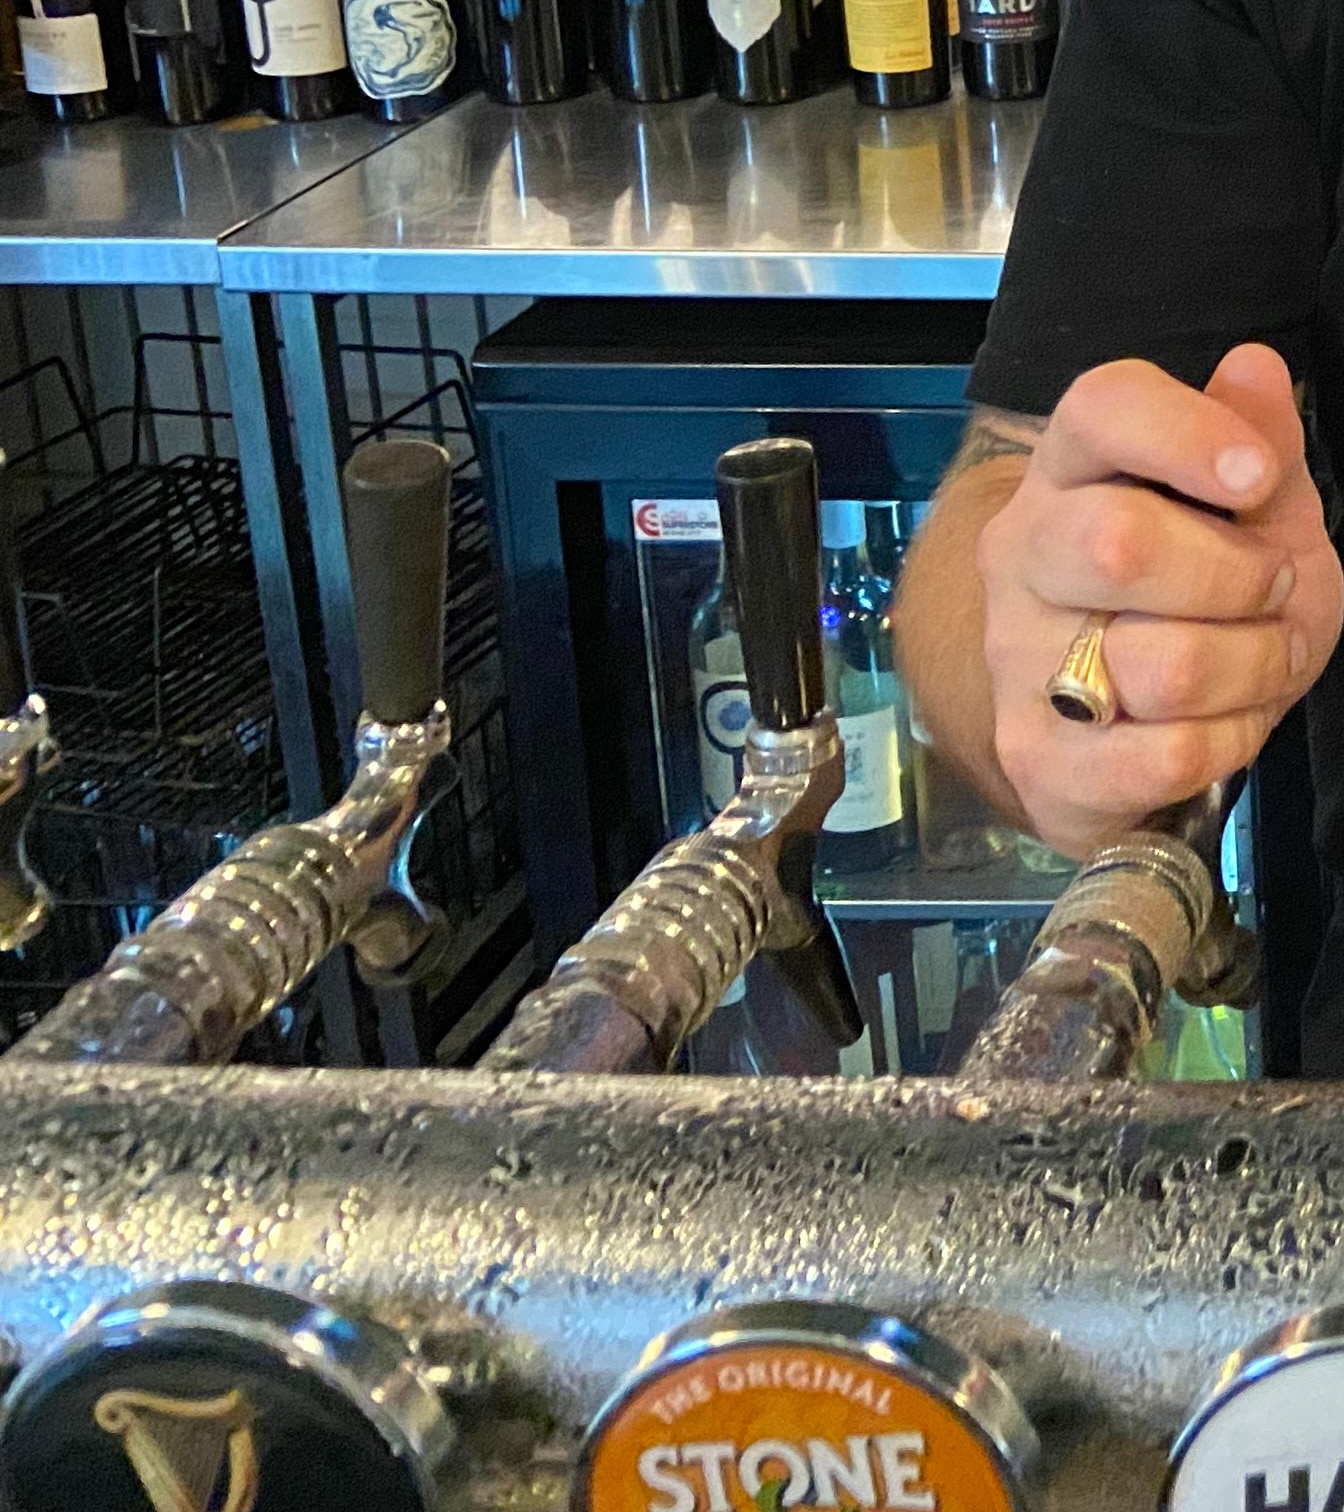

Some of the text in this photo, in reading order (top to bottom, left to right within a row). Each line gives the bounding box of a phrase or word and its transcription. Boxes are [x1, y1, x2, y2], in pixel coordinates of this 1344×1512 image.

[650, 1359, 893, 1424] THE ORIGINAL
[636, 1430, 936, 1512] STONE
